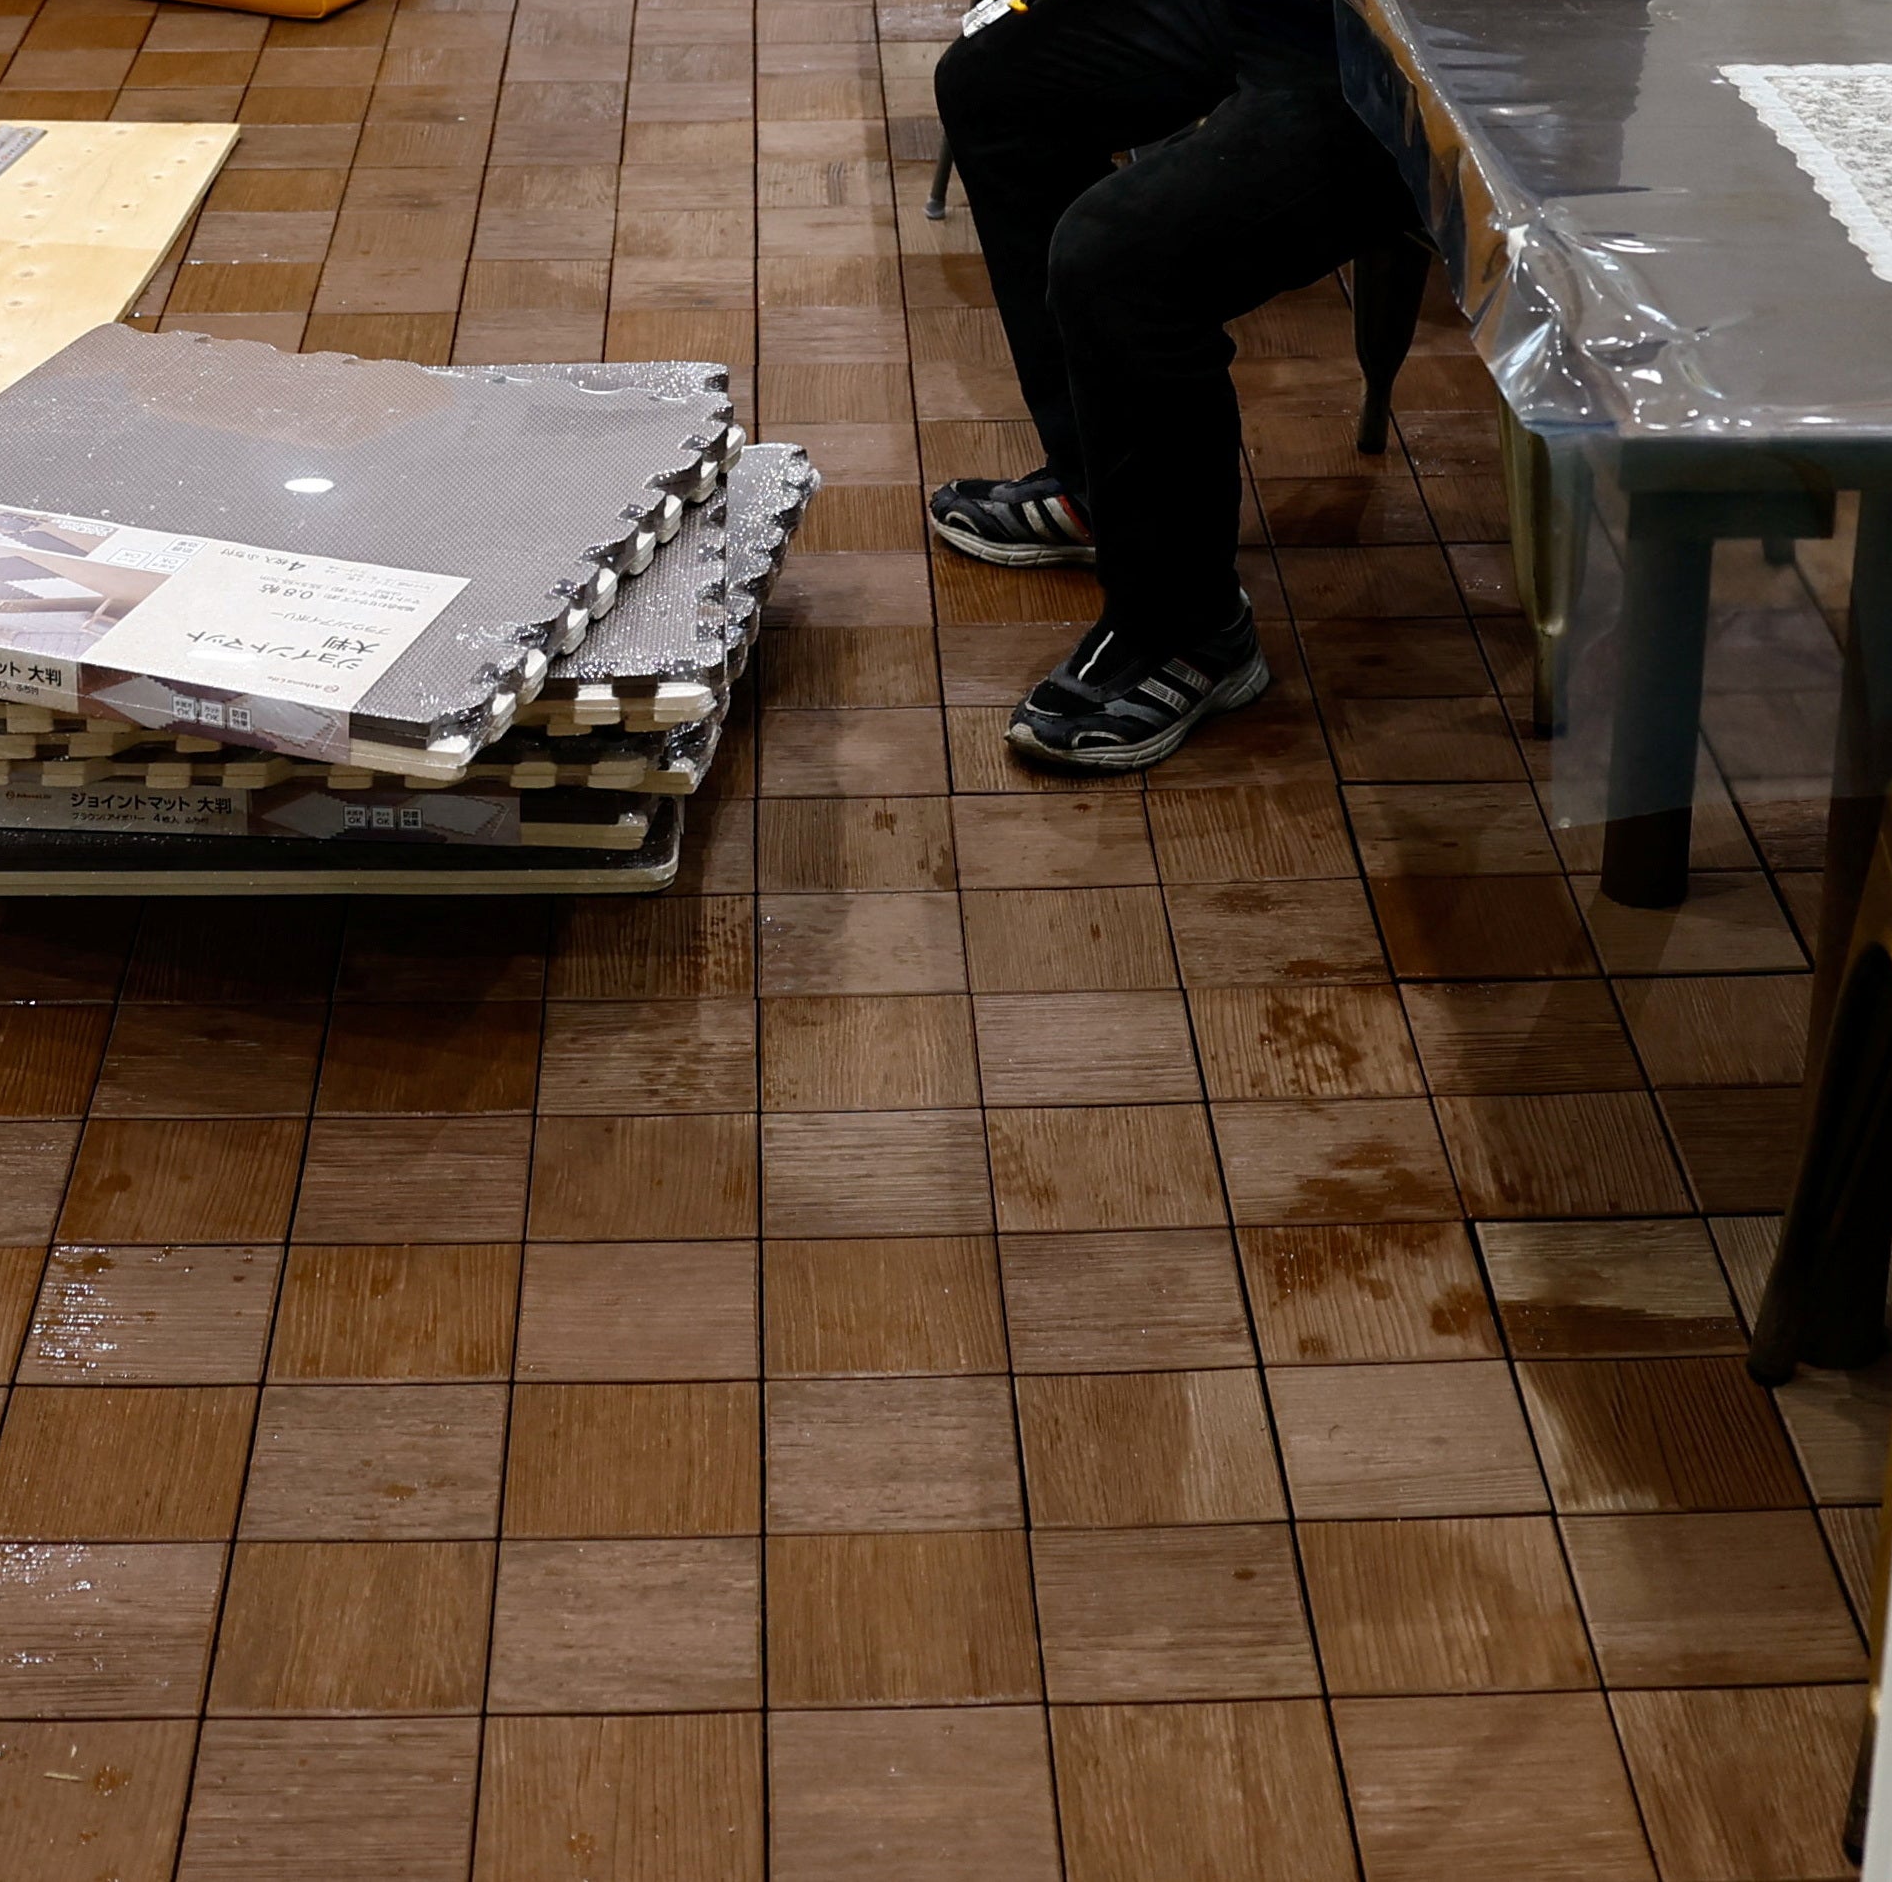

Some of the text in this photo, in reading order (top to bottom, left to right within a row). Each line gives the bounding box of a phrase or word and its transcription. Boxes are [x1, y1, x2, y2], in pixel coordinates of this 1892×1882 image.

[185, 632, 363, 671] ジョイントマット
[321, 635, 380, 655] 大判
[28, 666, 62, 687] 大判
[71, 793, 232, 815] ジョイントマット 大判
